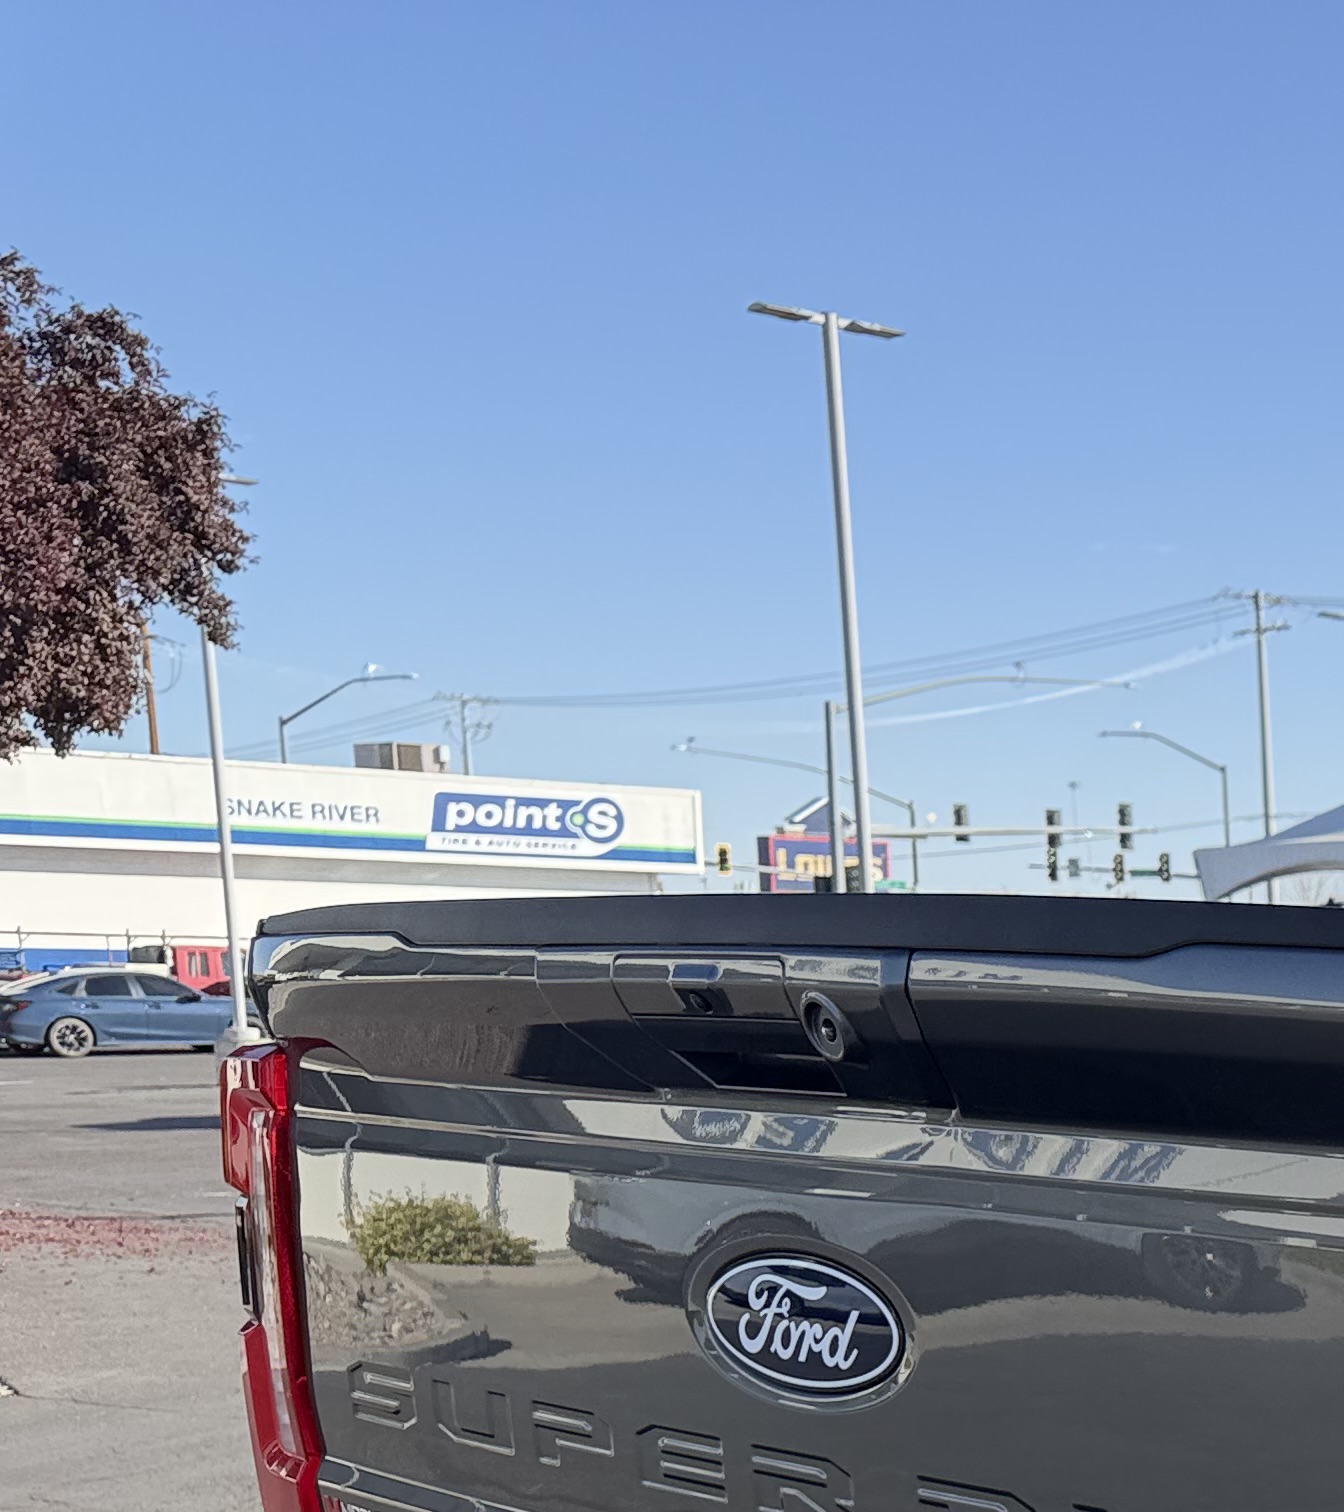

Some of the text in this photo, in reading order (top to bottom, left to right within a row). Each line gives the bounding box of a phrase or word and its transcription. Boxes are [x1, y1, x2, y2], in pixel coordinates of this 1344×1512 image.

[226, 798, 381, 824] SNAKE RIVER
[445, 798, 619, 839] point S
[738, 1273, 861, 1371] Ford
